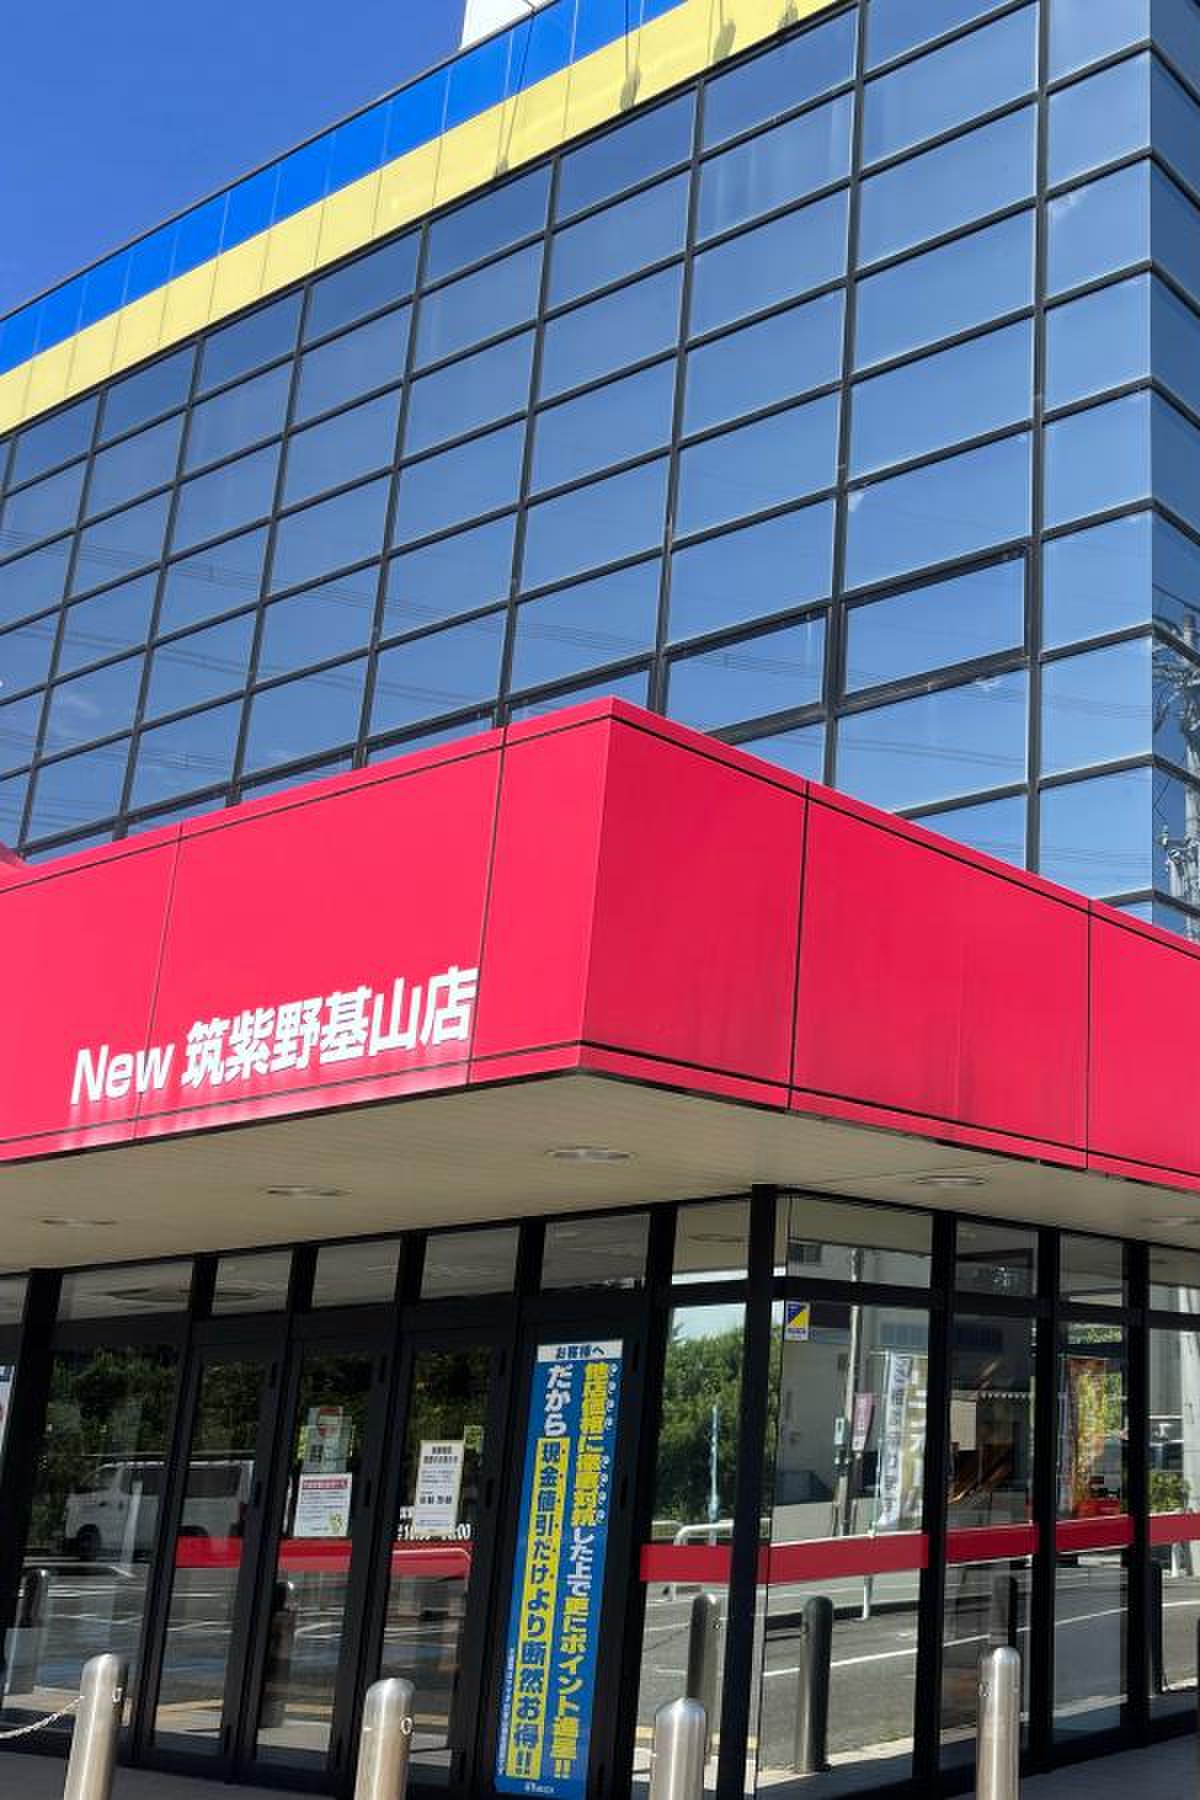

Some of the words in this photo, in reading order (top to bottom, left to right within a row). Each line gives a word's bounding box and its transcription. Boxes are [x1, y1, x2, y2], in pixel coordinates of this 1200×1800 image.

[71, 1043, 175, 1105] New
[181, 966, 479, 1089] 筑紫野基山店
